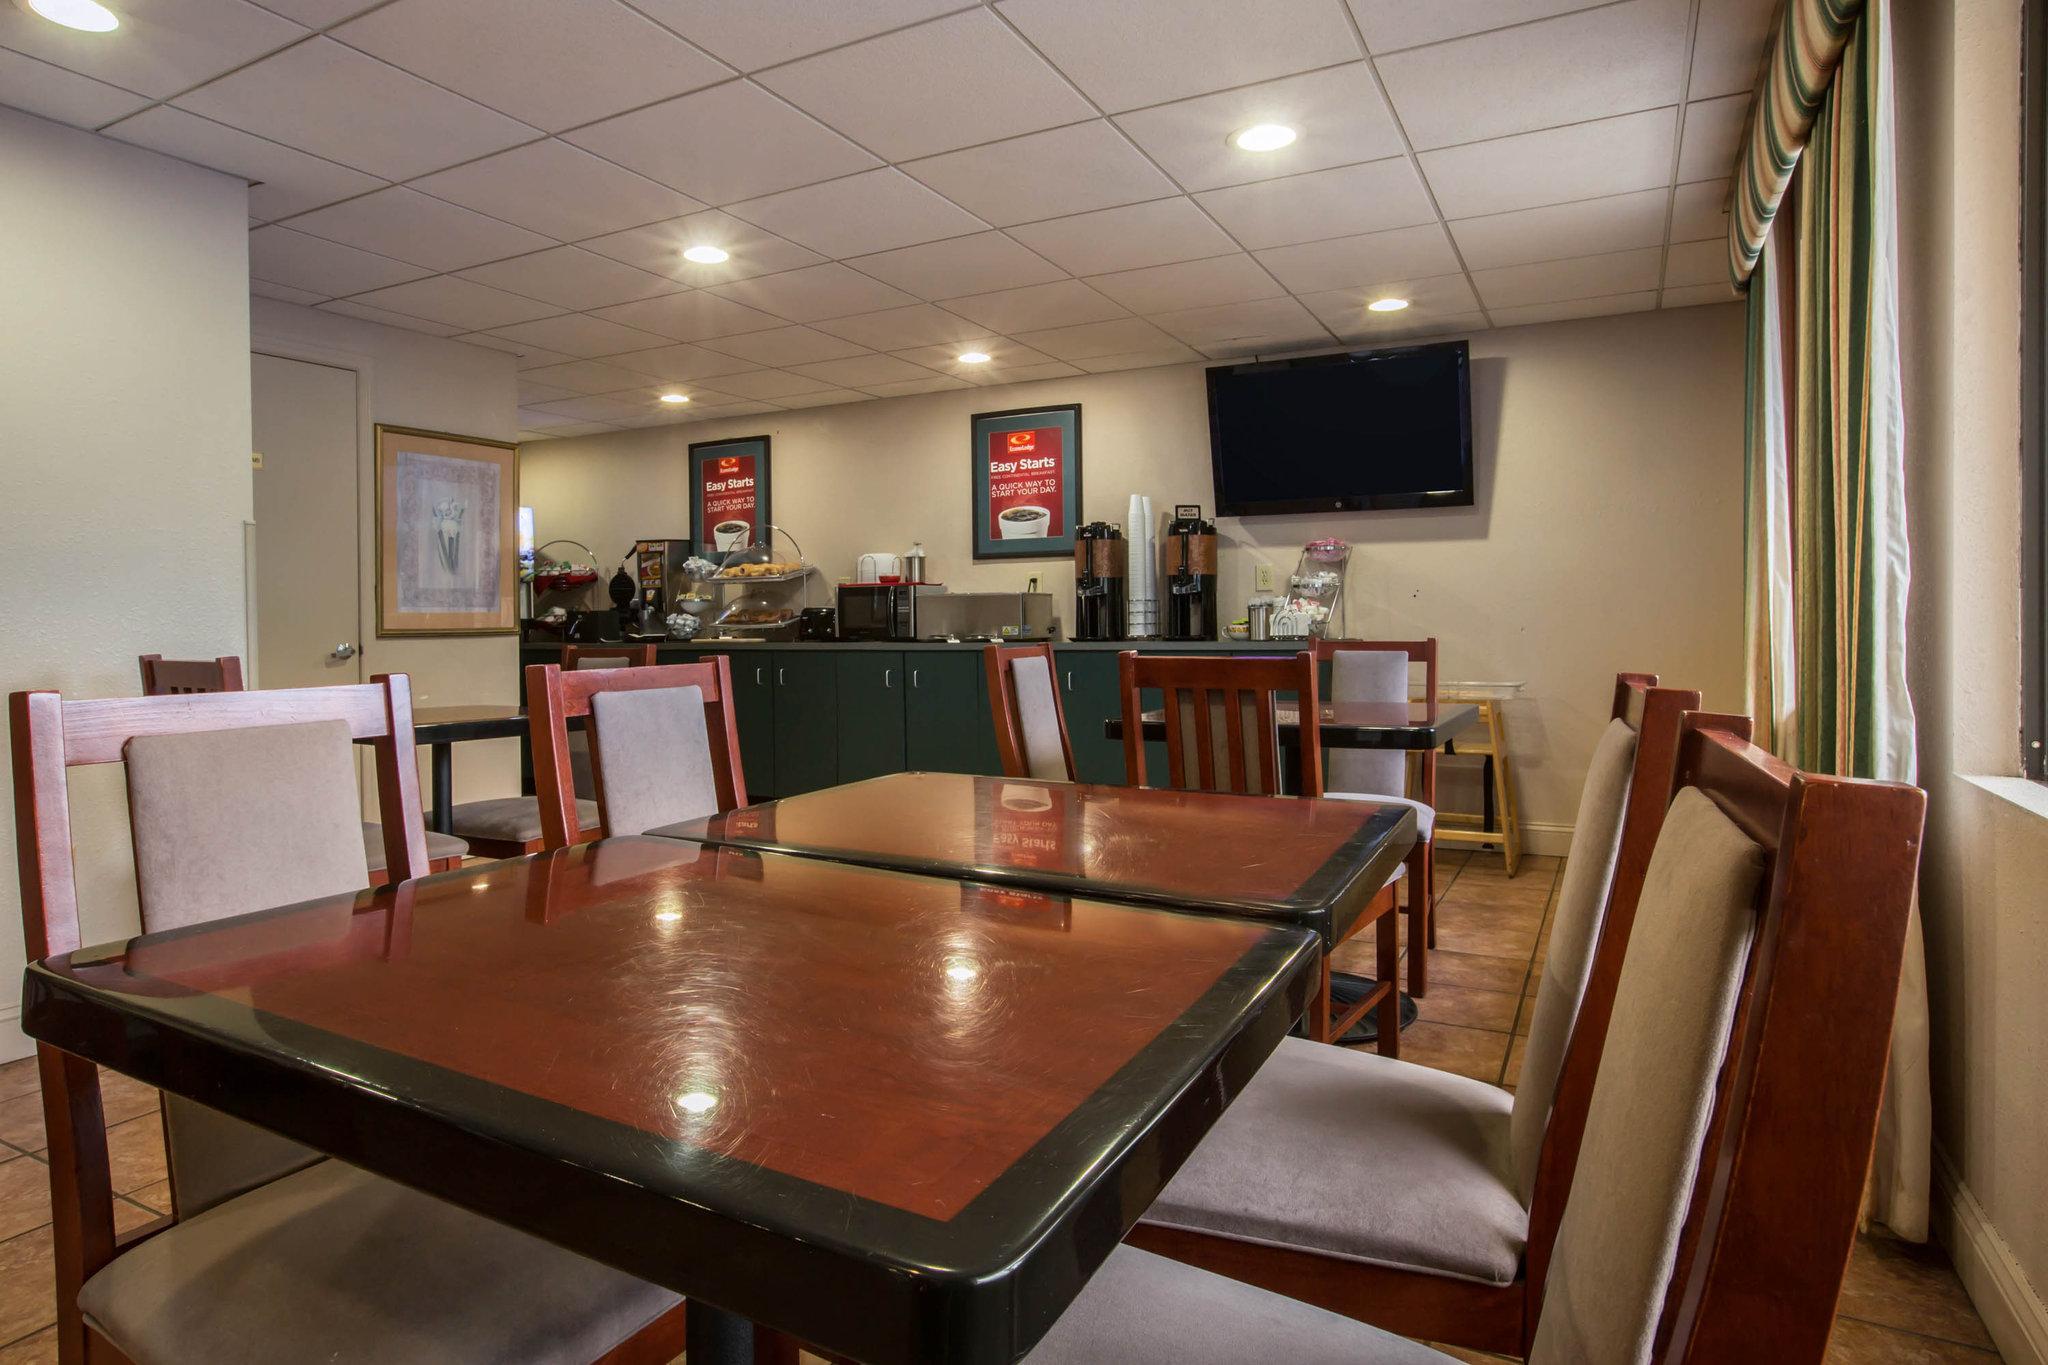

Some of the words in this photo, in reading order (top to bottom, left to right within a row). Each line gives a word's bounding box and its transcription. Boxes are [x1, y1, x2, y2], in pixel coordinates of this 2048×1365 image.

[990, 461, 1018, 473] Easy
[1019, 457, 1056, 470] Starts
[706, 481, 727, 492] Easy
[727, 477, 754, 489] Starts
[998, 481, 1024, 491] QUICK
[1025, 480, 1043, 488] WAY
[1044, 478, 1056, 486] TO
[991, 489, 1015, 498] START
[1017, 487, 1039, 496] YOUR
[1039, 486, 1057, 494] DAY.
[707, 505, 725, 513] START
[725, 503, 742, 511] YOUR
[712, 499, 731, 507] QUICK
